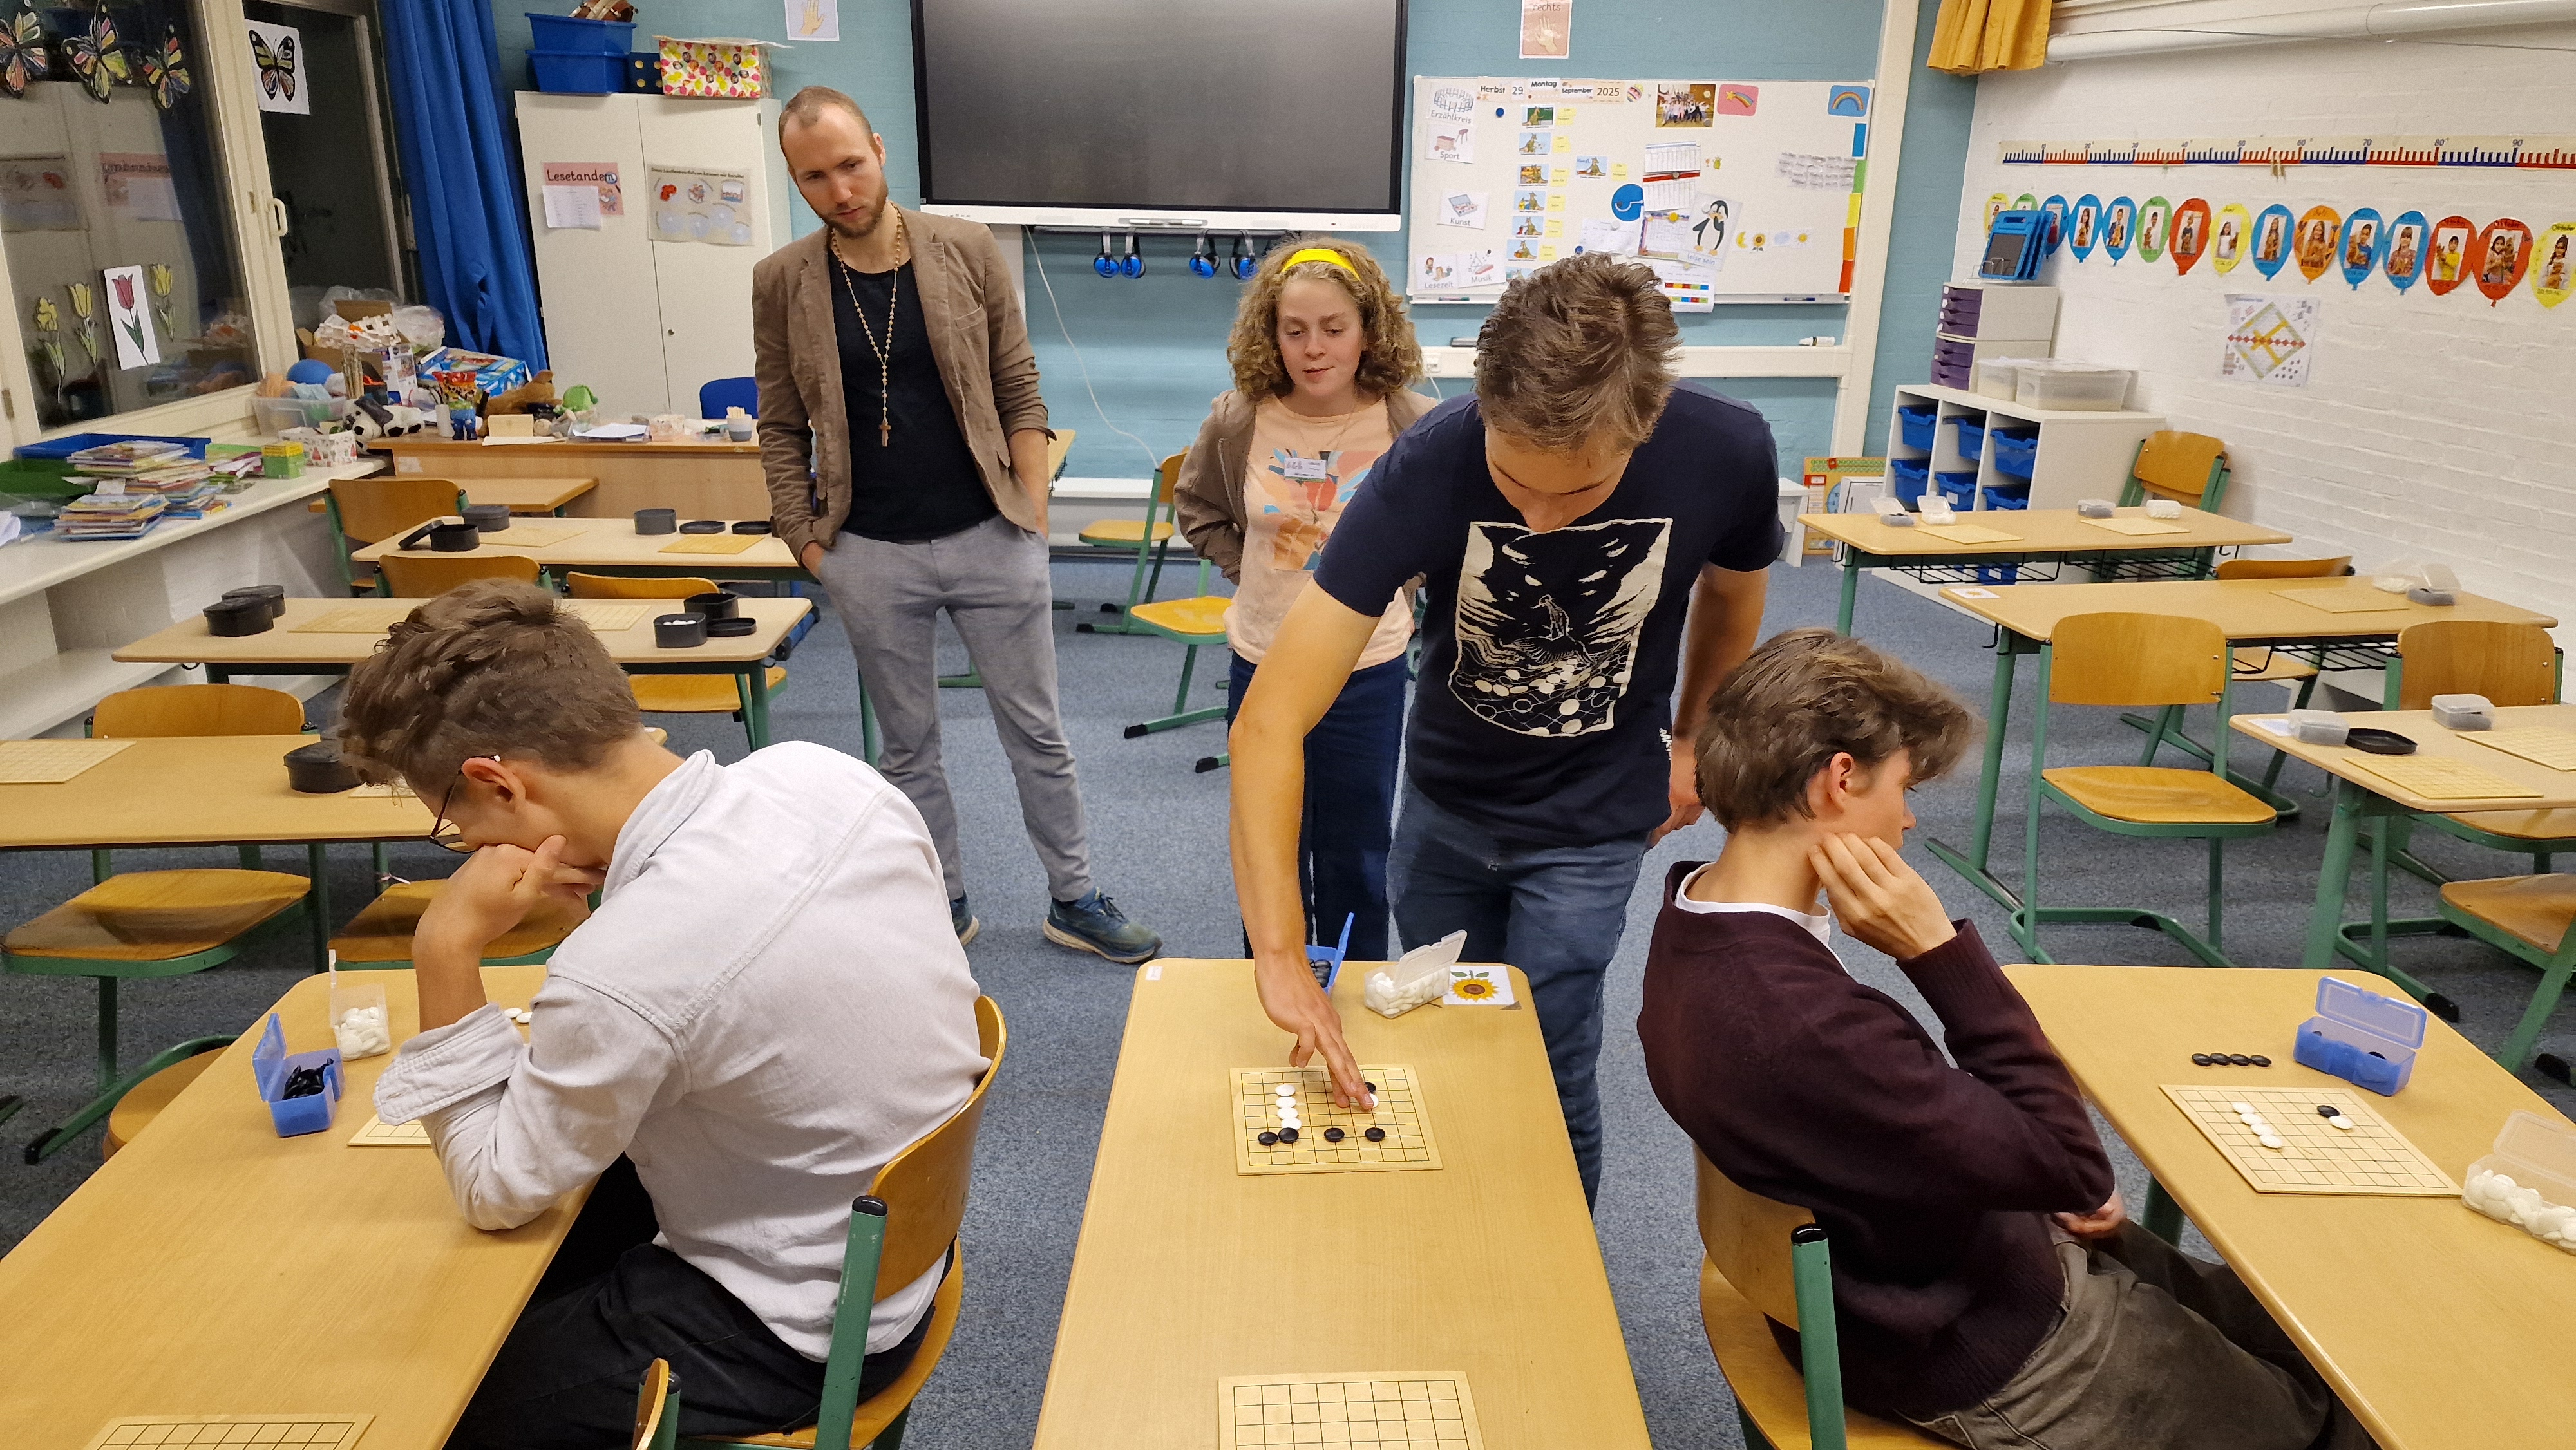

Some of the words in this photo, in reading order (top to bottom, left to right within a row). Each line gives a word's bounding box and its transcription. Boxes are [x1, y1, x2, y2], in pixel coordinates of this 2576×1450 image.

[1481, 86, 1506, 94] Herbst
[1512, 86, 1524, 95] 29
[1596, 87, 1620, 96] 2025
[1431, 109, 1472, 124] Erzählkreis
[2297, 138, 2306, 147] 60
[2512, 138, 2523, 147] 90
[1440, 151, 1460, 160] Sport
[547, 169, 616, 182] Lesetandem
[1450, 217, 1471, 226] Kunst
[1687, 252, 1701, 263] leise
[1703, 256, 1716, 265] sein
[1471, 274, 1492, 283] Musik
